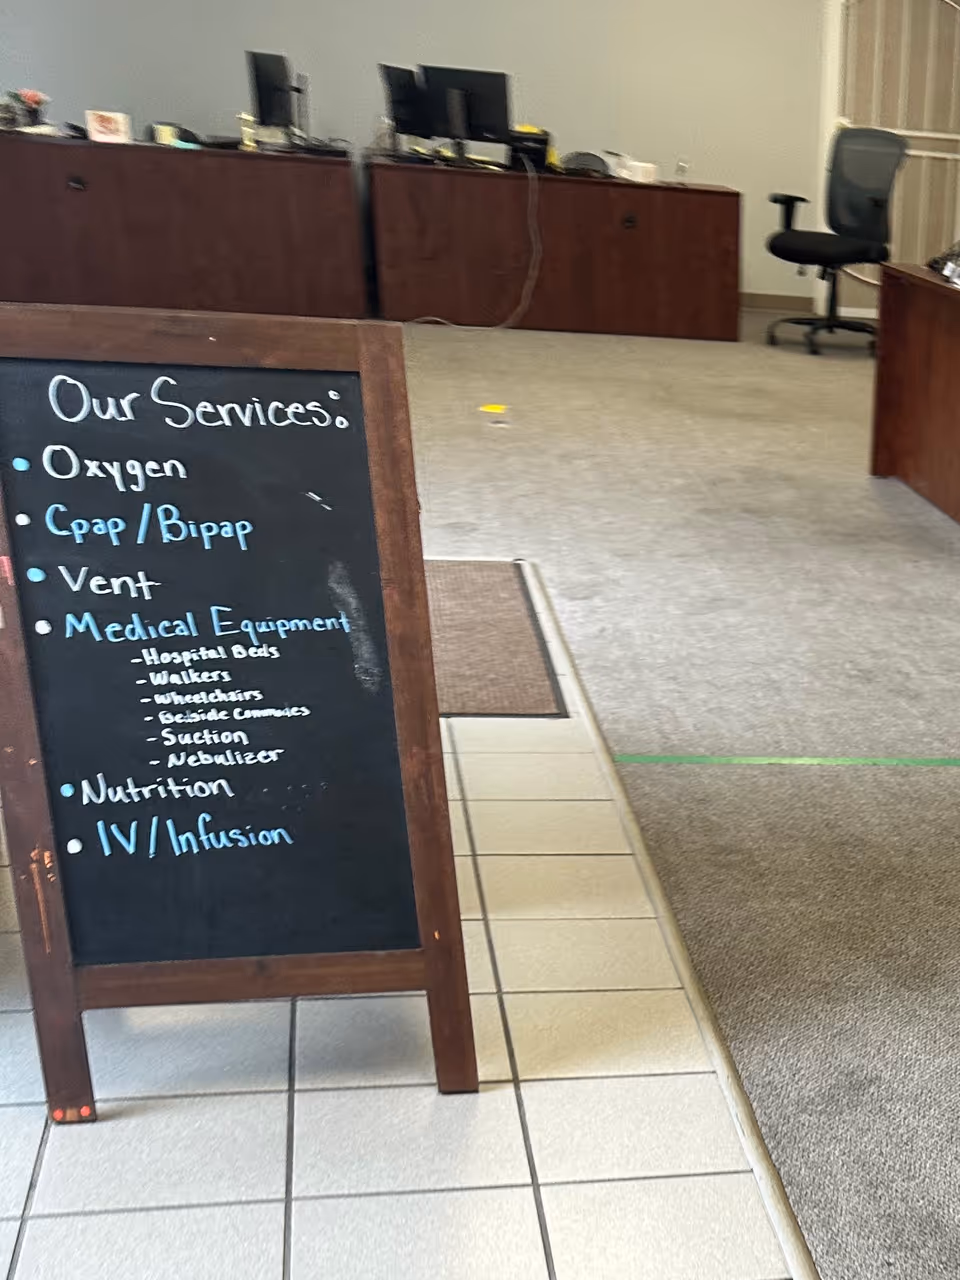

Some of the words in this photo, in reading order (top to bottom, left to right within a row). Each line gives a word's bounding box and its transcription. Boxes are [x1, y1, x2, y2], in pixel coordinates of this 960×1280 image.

[48, 374, 141, 423] Our
[149, 375, 350, 429] Services:
[42, 444, 188, 492] Oxygen
[57, 564, 161, 601] Vent
[64, 611, 200, 643] Medical
[209, 604, 353, 646] Equipment
[230, 643, 281, 659] Beds
[149, 668, 232, 686] Walkers
[153, 688, 265, 705] Wheelchairs
[160, 727, 250, 747] Suction
[167, 748, 286, 768] Nebulizer
[80, 772, 235, 807] Nutrition
